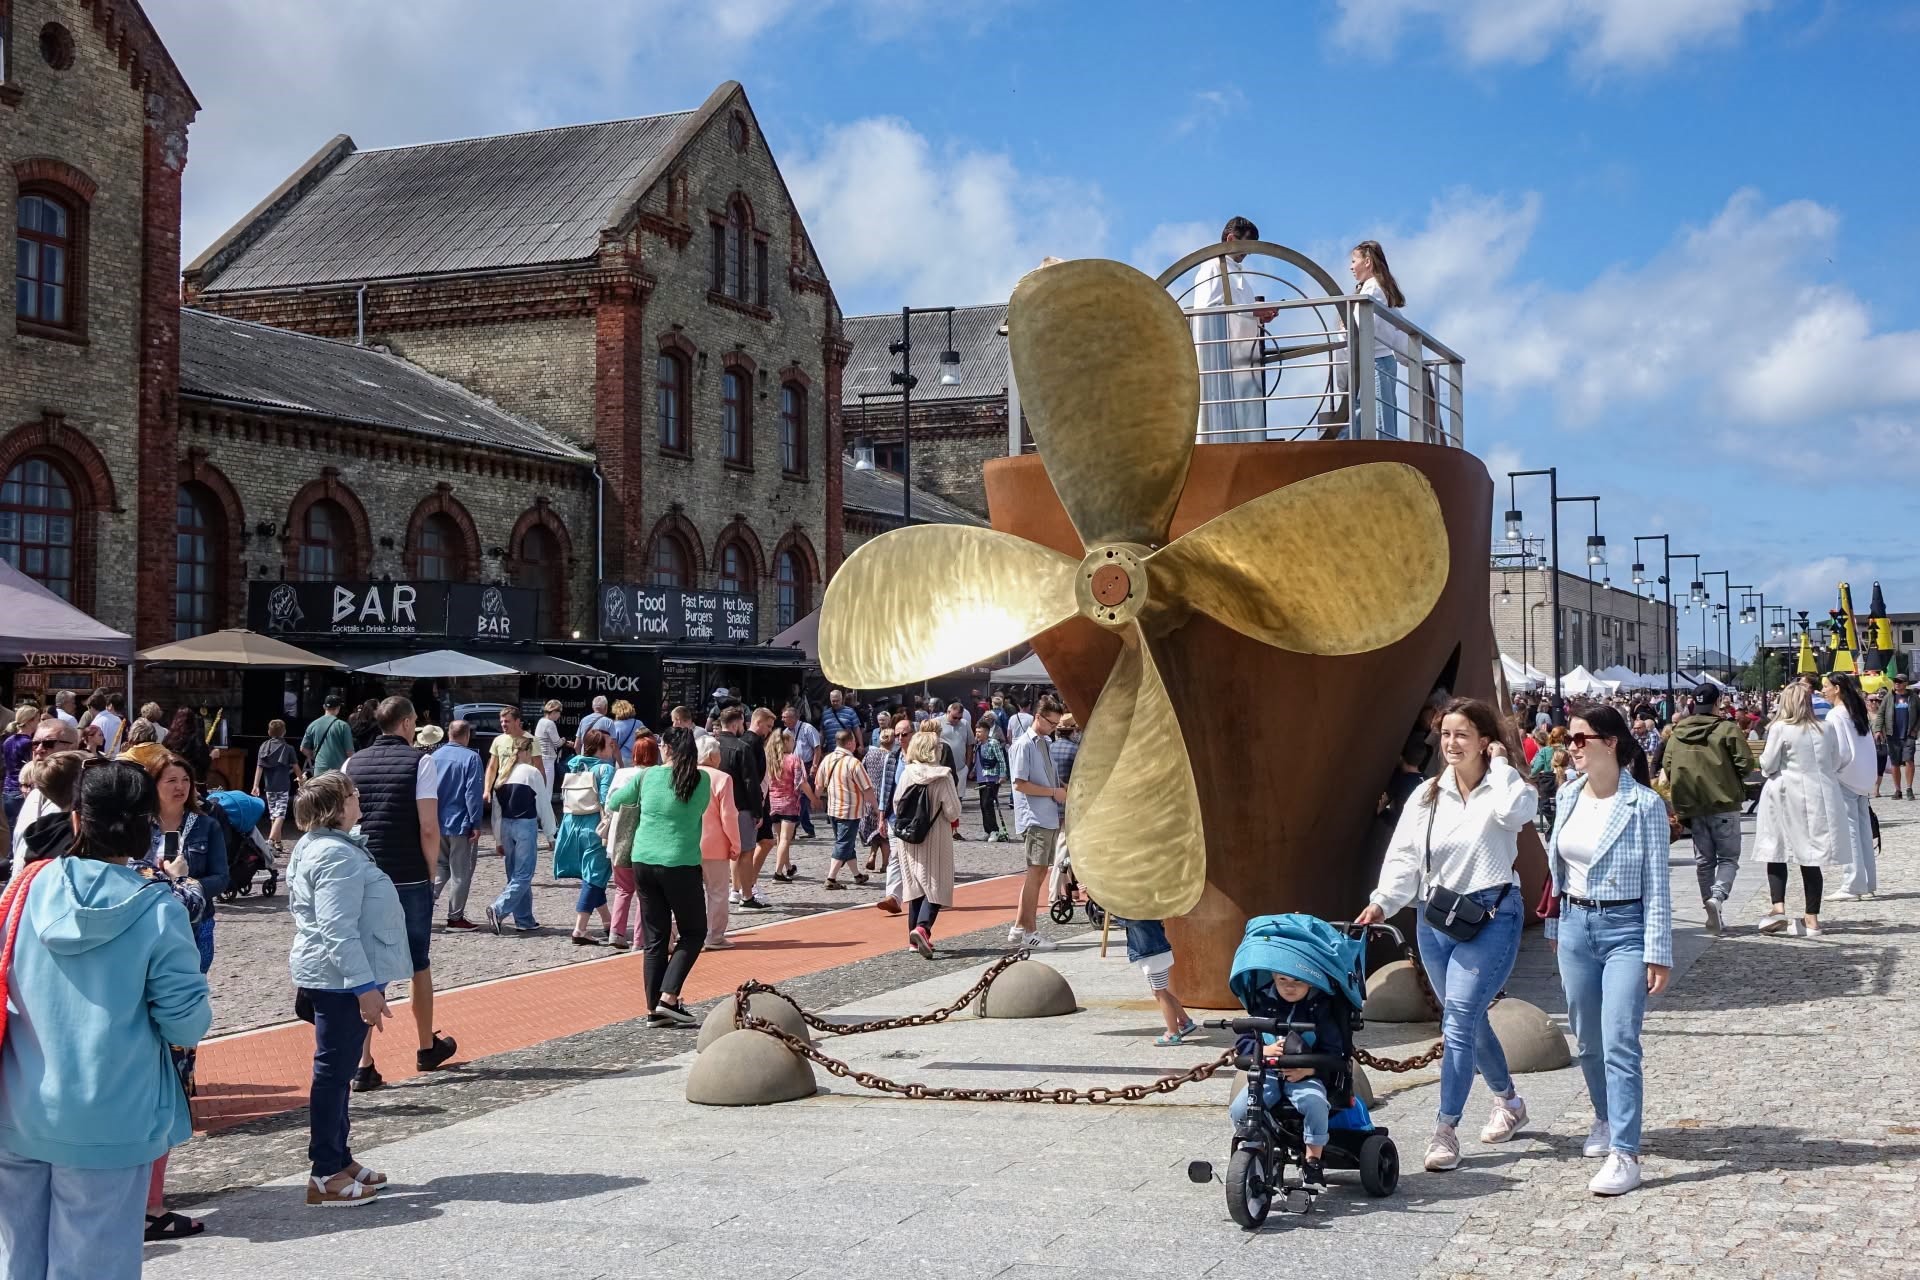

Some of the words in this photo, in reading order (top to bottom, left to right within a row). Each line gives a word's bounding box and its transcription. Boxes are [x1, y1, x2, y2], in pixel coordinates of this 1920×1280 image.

[331, 583, 417, 624] BAR
[637, 591, 666, 612] Food
[681, 593, 697, 609] Fast
[698, 595, 716, 610] Food
[723, 598, 736, 611] Hot
[737, 599, 754, 613] Dogs
[477, 615, 511, 634] BAR
[635, 612, 669, 633] Truck
[685, 610, 713, 625] Burgers
[726, 612, 751, 625] Snacks
[332, 624, 360, 633] Cocktails
[366, 624, 386, 633] Drinks
[392, 624, 415, 633] Snacks
[728, 626, 749, 639] Drinks
[22, 651, 118, 668] VENTSPILS
[545, 675, 582, 690] OOD
[587, 675, 641, 692] TRUCK
